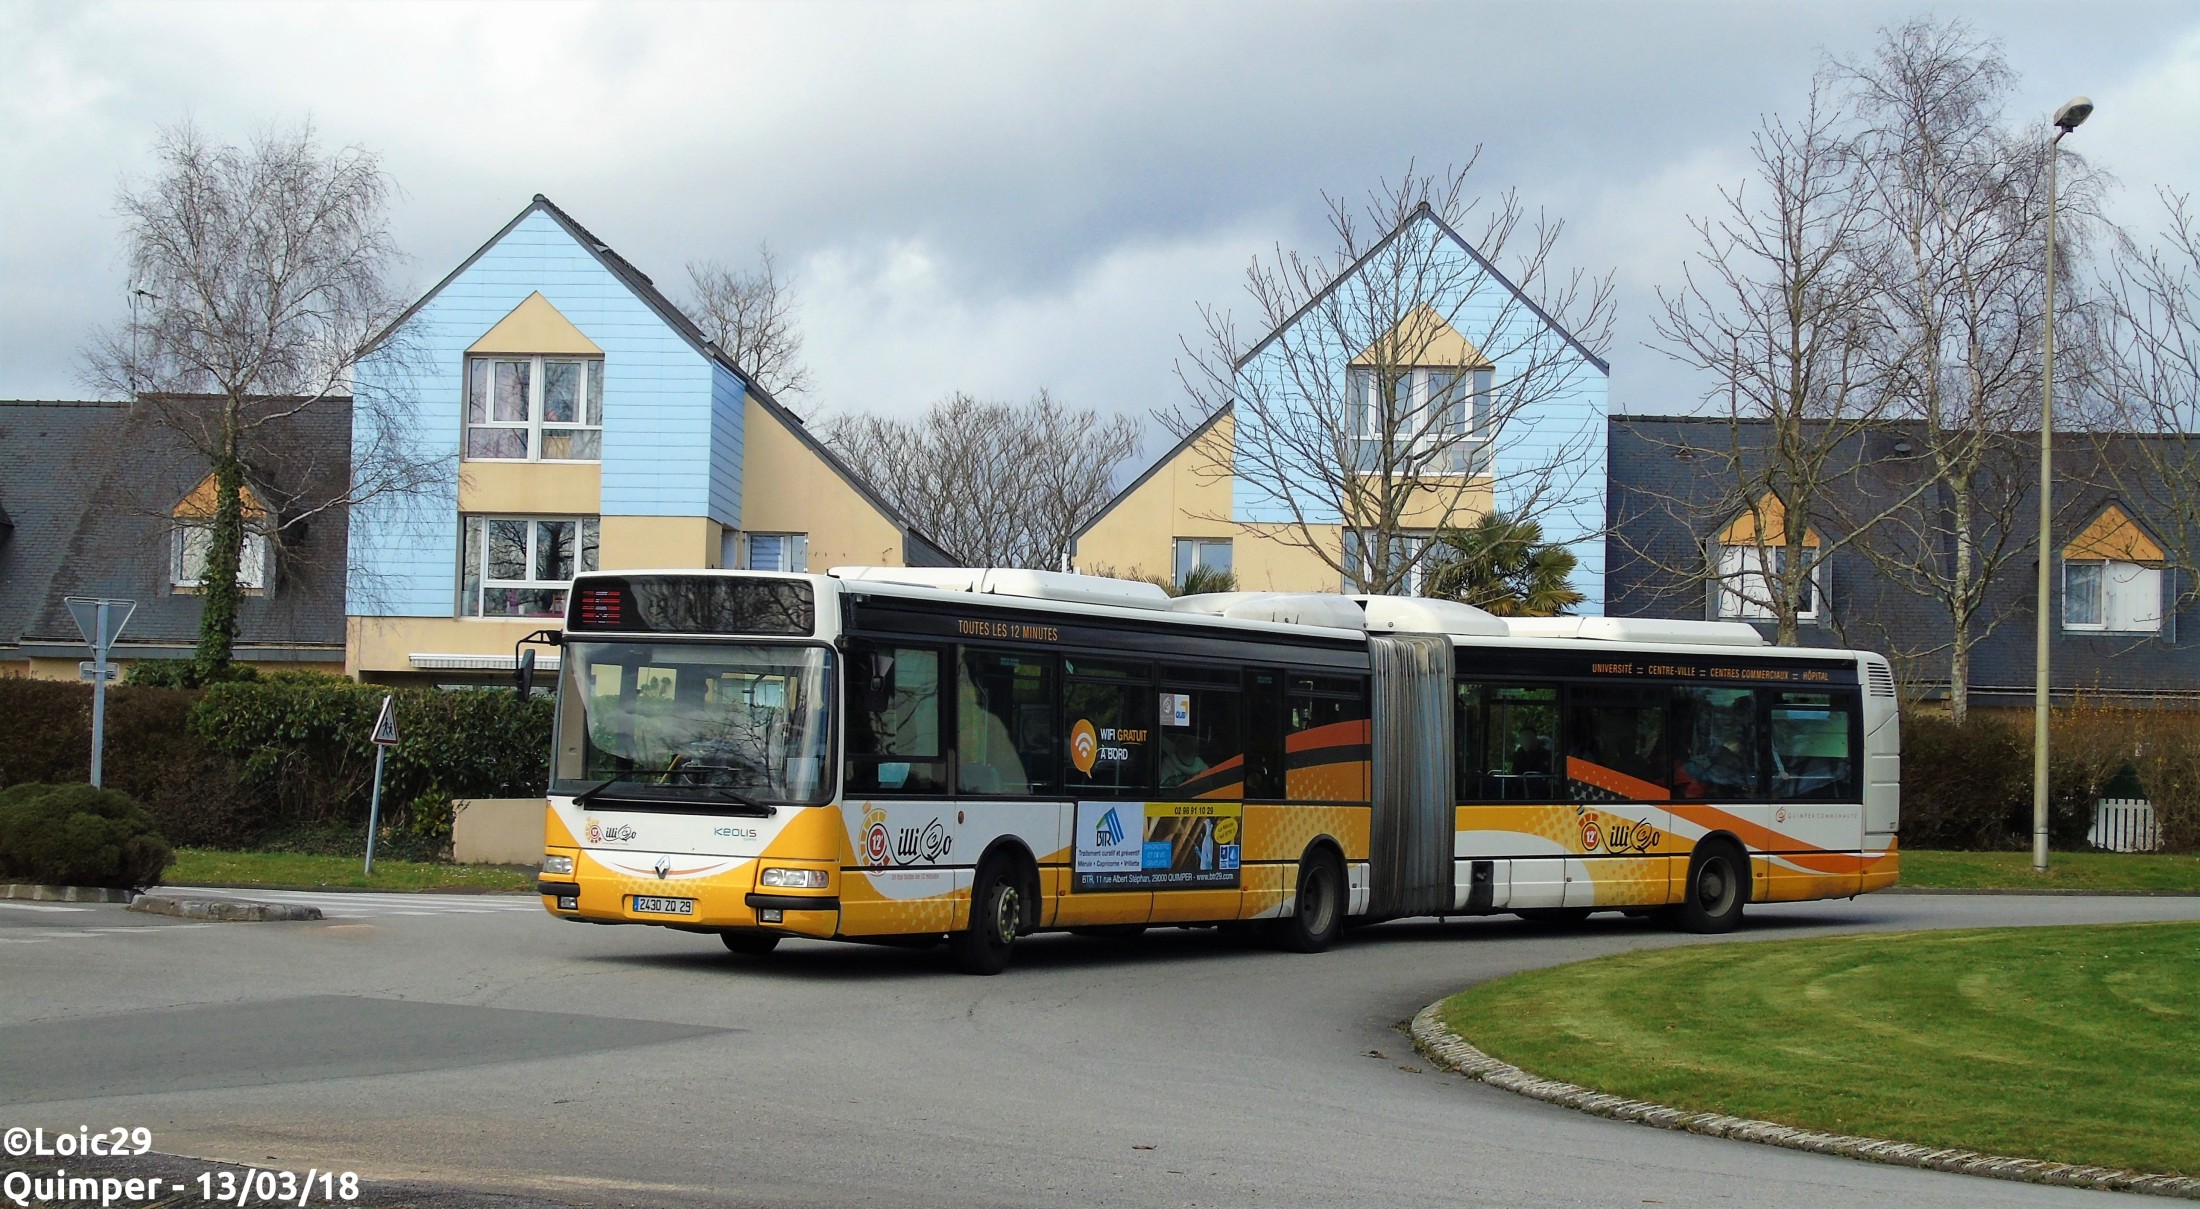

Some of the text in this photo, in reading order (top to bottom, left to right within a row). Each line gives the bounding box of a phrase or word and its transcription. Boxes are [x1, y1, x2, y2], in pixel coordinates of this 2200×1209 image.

[958, 620, 1058, 641] TOUTES LES 12 MINUTES
[1592, 662, 1829, 681] UNIVERSITÉ CENTRE-VILLE CENTRES COMMERCIAUX HÔPITAL
[1100, 728, 1148, 742] WIFI GRATUIT
[1107, 748, 1129, 760] BORD
[1168, 872, 1193, 882] QUIMPER
[639, 898, 691, 913] 2430 ZQ 29
